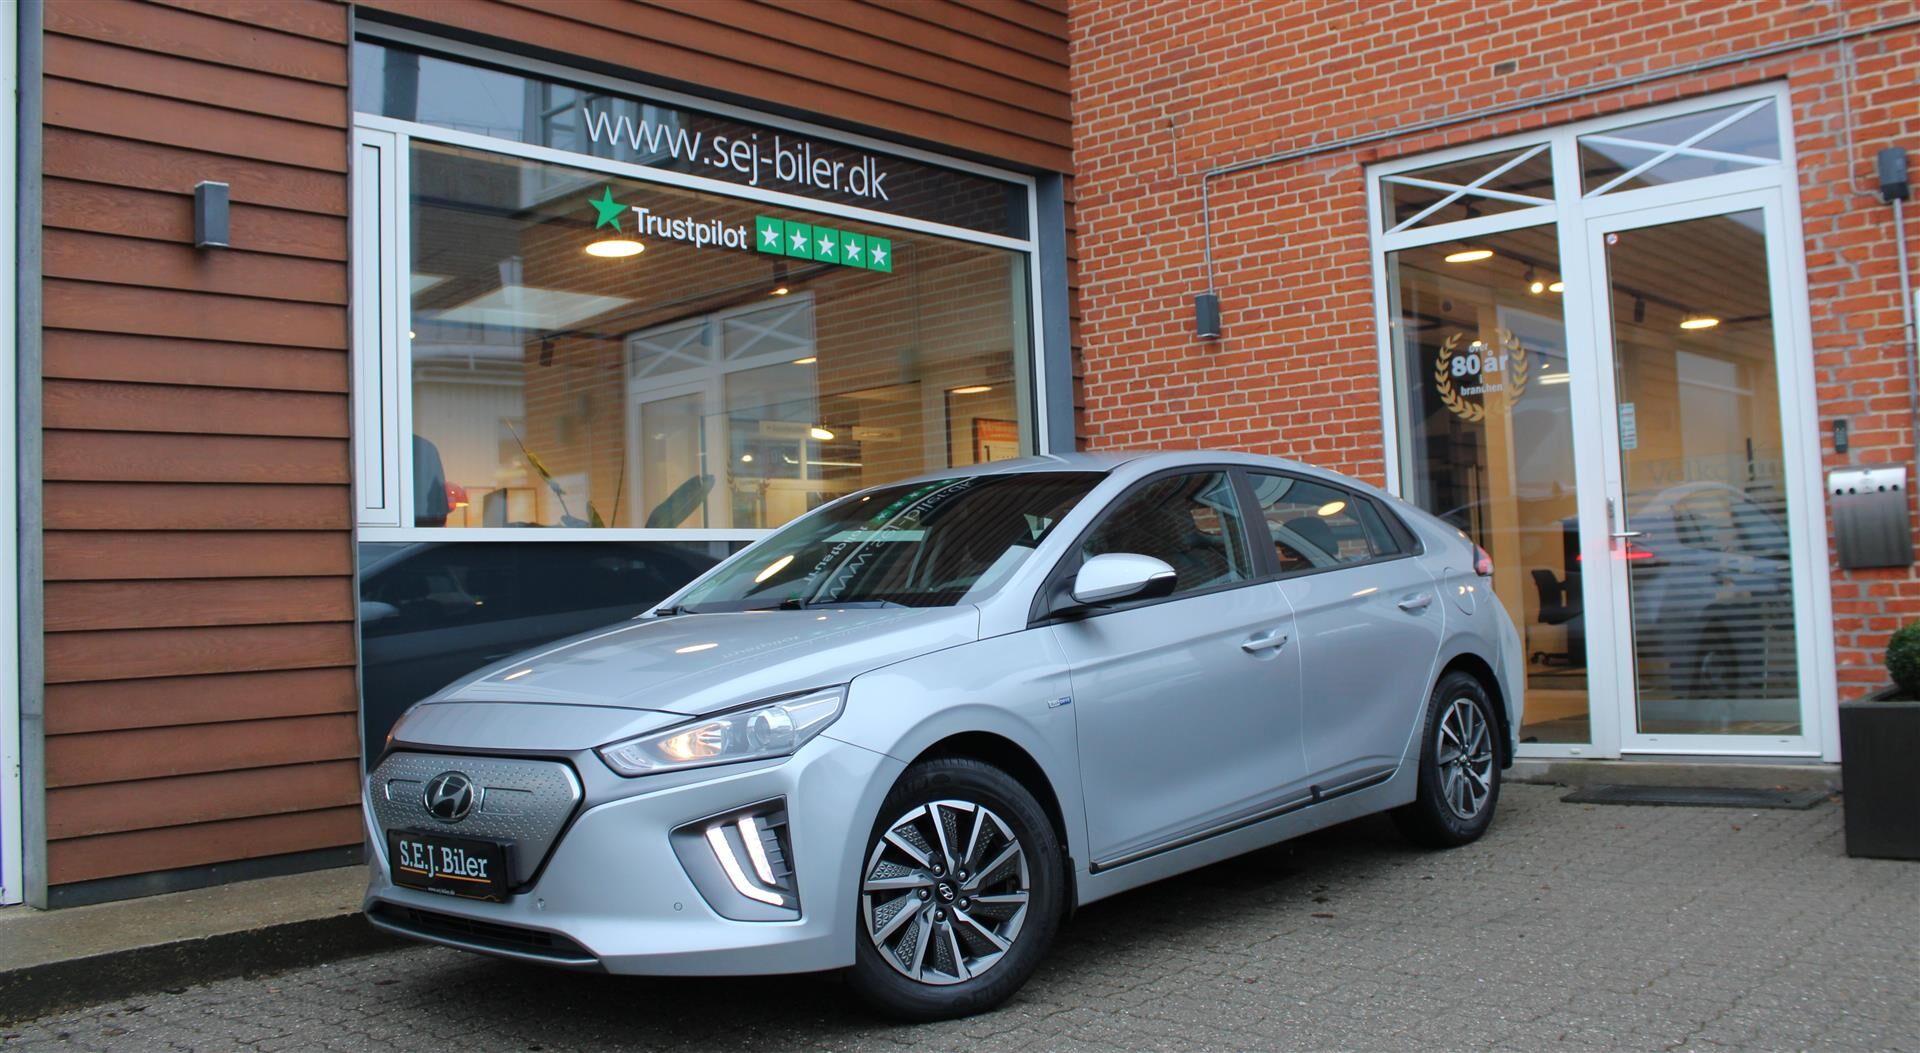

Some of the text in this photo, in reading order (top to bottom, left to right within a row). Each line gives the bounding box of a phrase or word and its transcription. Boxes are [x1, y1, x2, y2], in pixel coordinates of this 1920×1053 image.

[583, 107, 889, 201] www.sej-biler.dk
[631, 205, 748, 249] Trustpilot
[1451, 350, 1508, 377] 80 år
[1460, 383, 1504, 396] branchen
[400, 840, 488, 878] S.E.J. Biler
